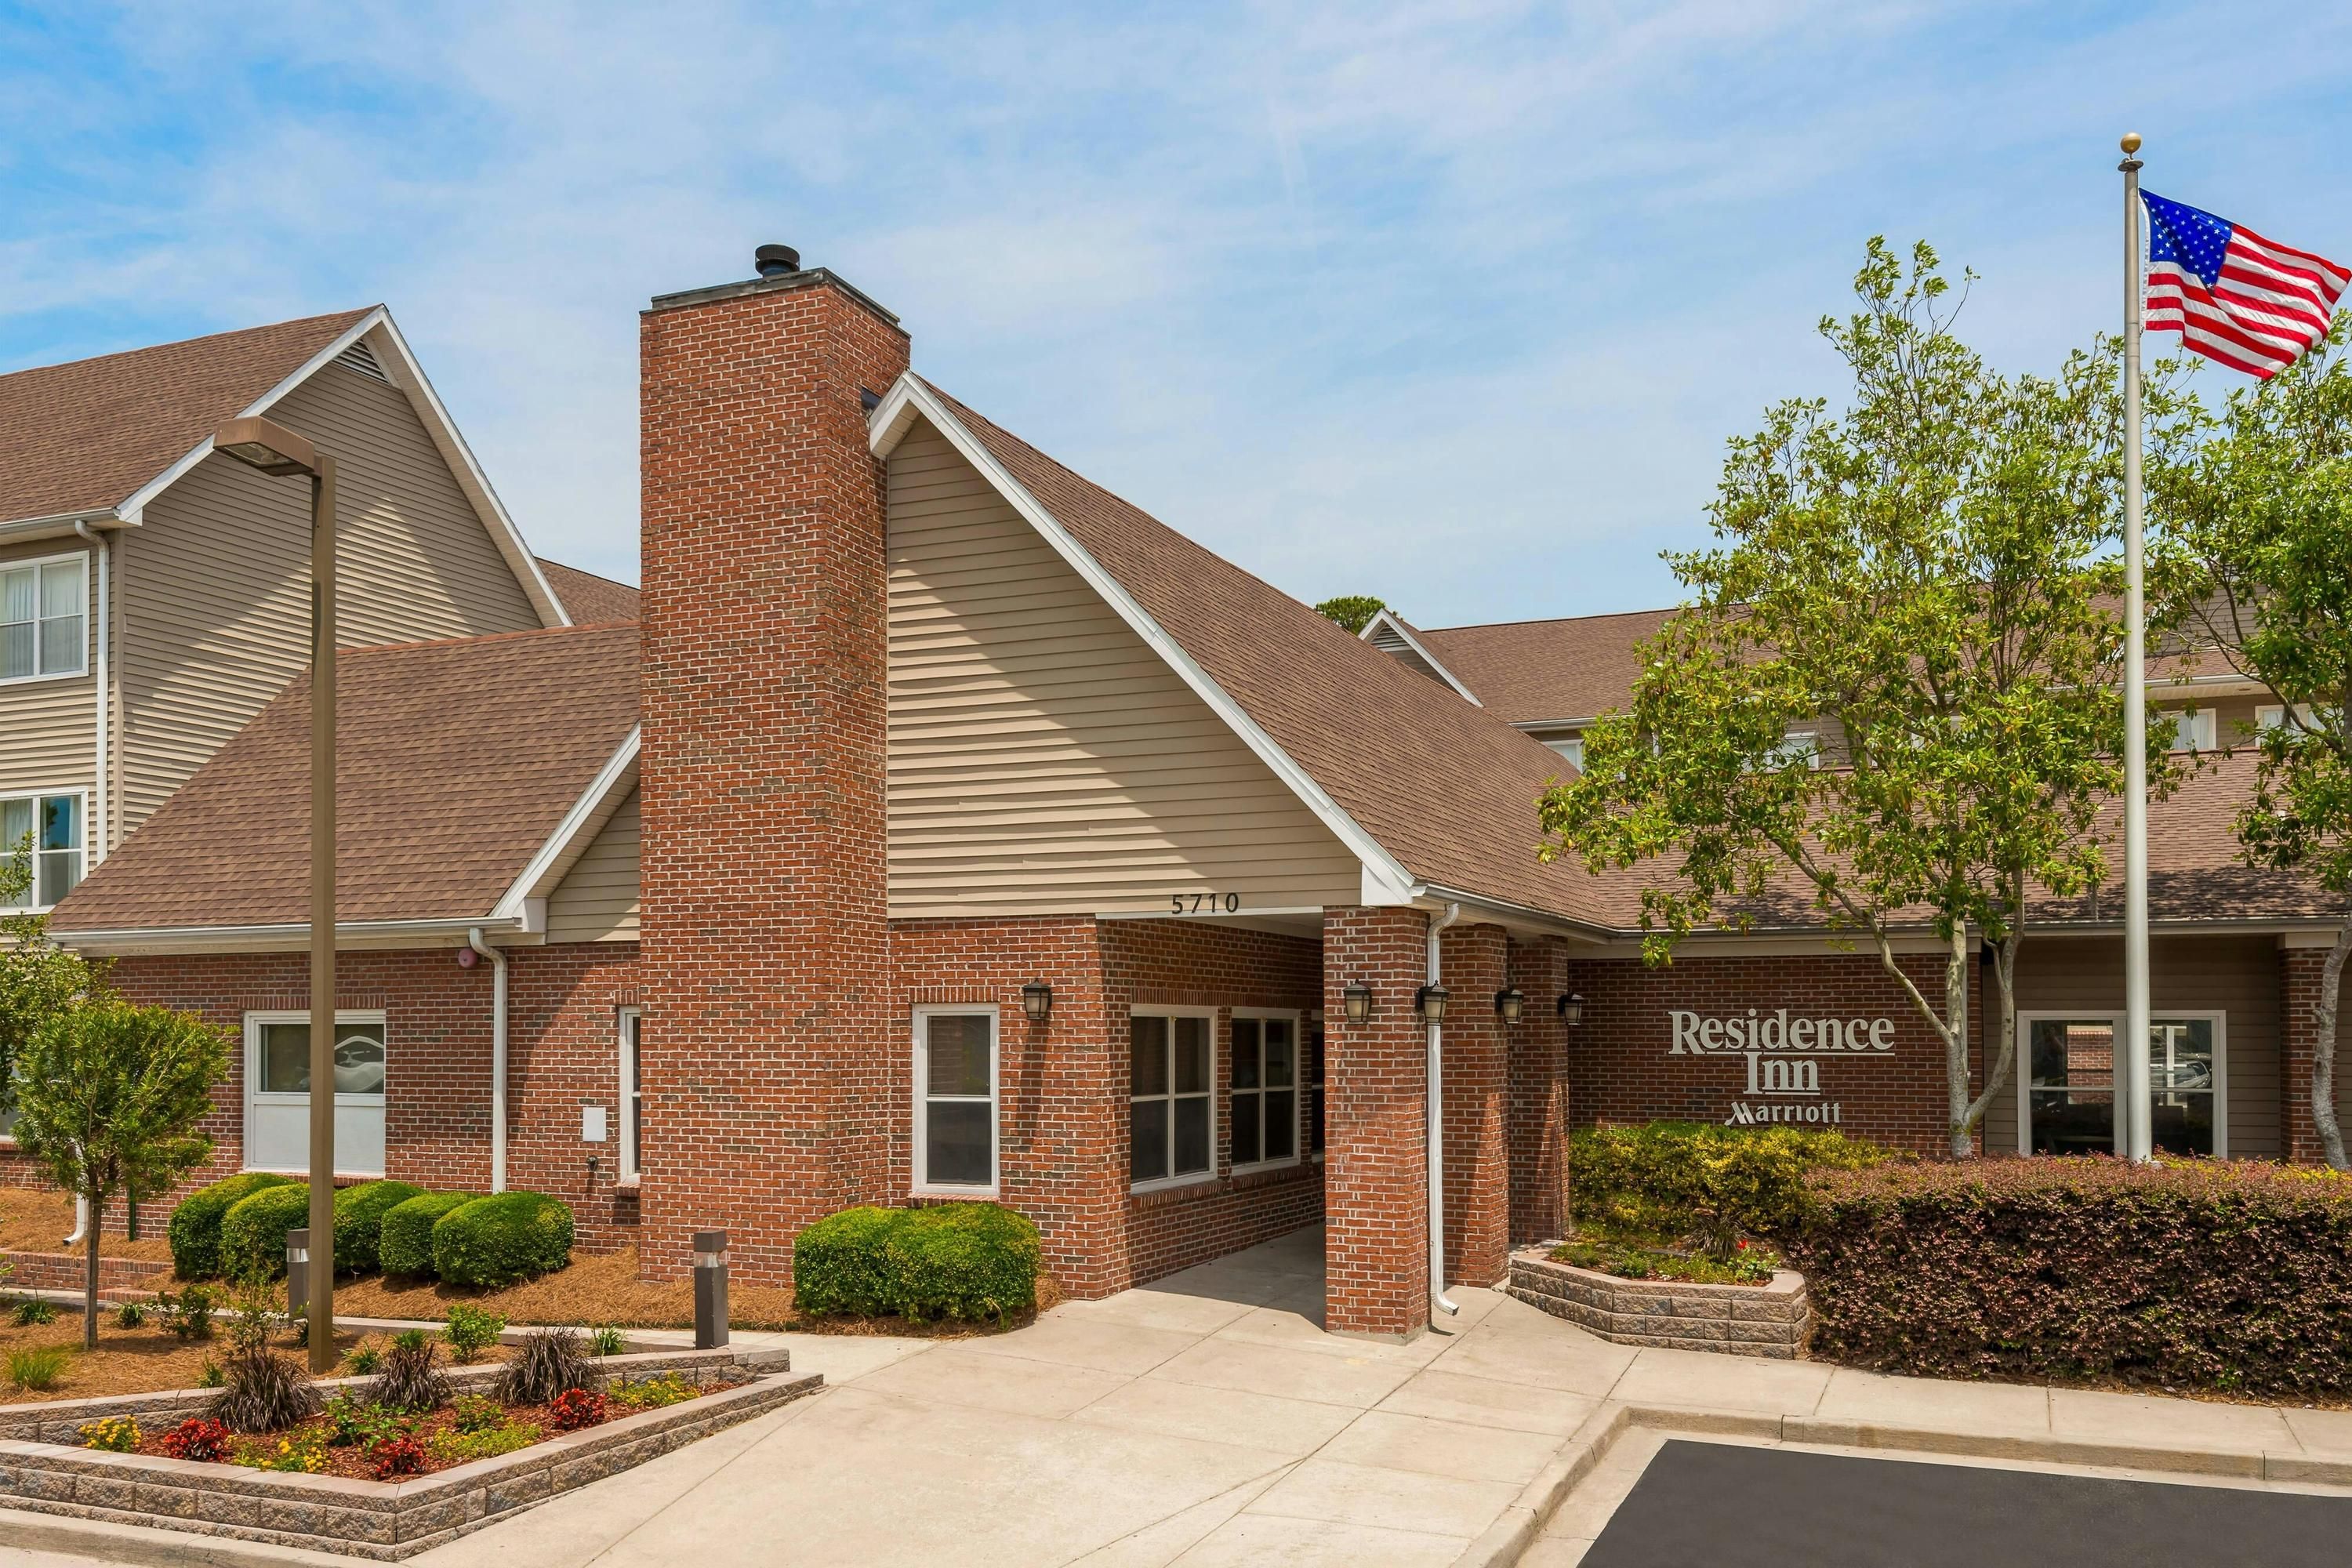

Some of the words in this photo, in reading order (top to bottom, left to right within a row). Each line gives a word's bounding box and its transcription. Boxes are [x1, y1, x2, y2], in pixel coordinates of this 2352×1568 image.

[1171, 892, 1239, 914] 5710
[1668, 1008, 1895, 1054] Residence
[1743, 1051, 1820, 1095] Inn
[1725, 1101, 1841, 1126] Marriott
